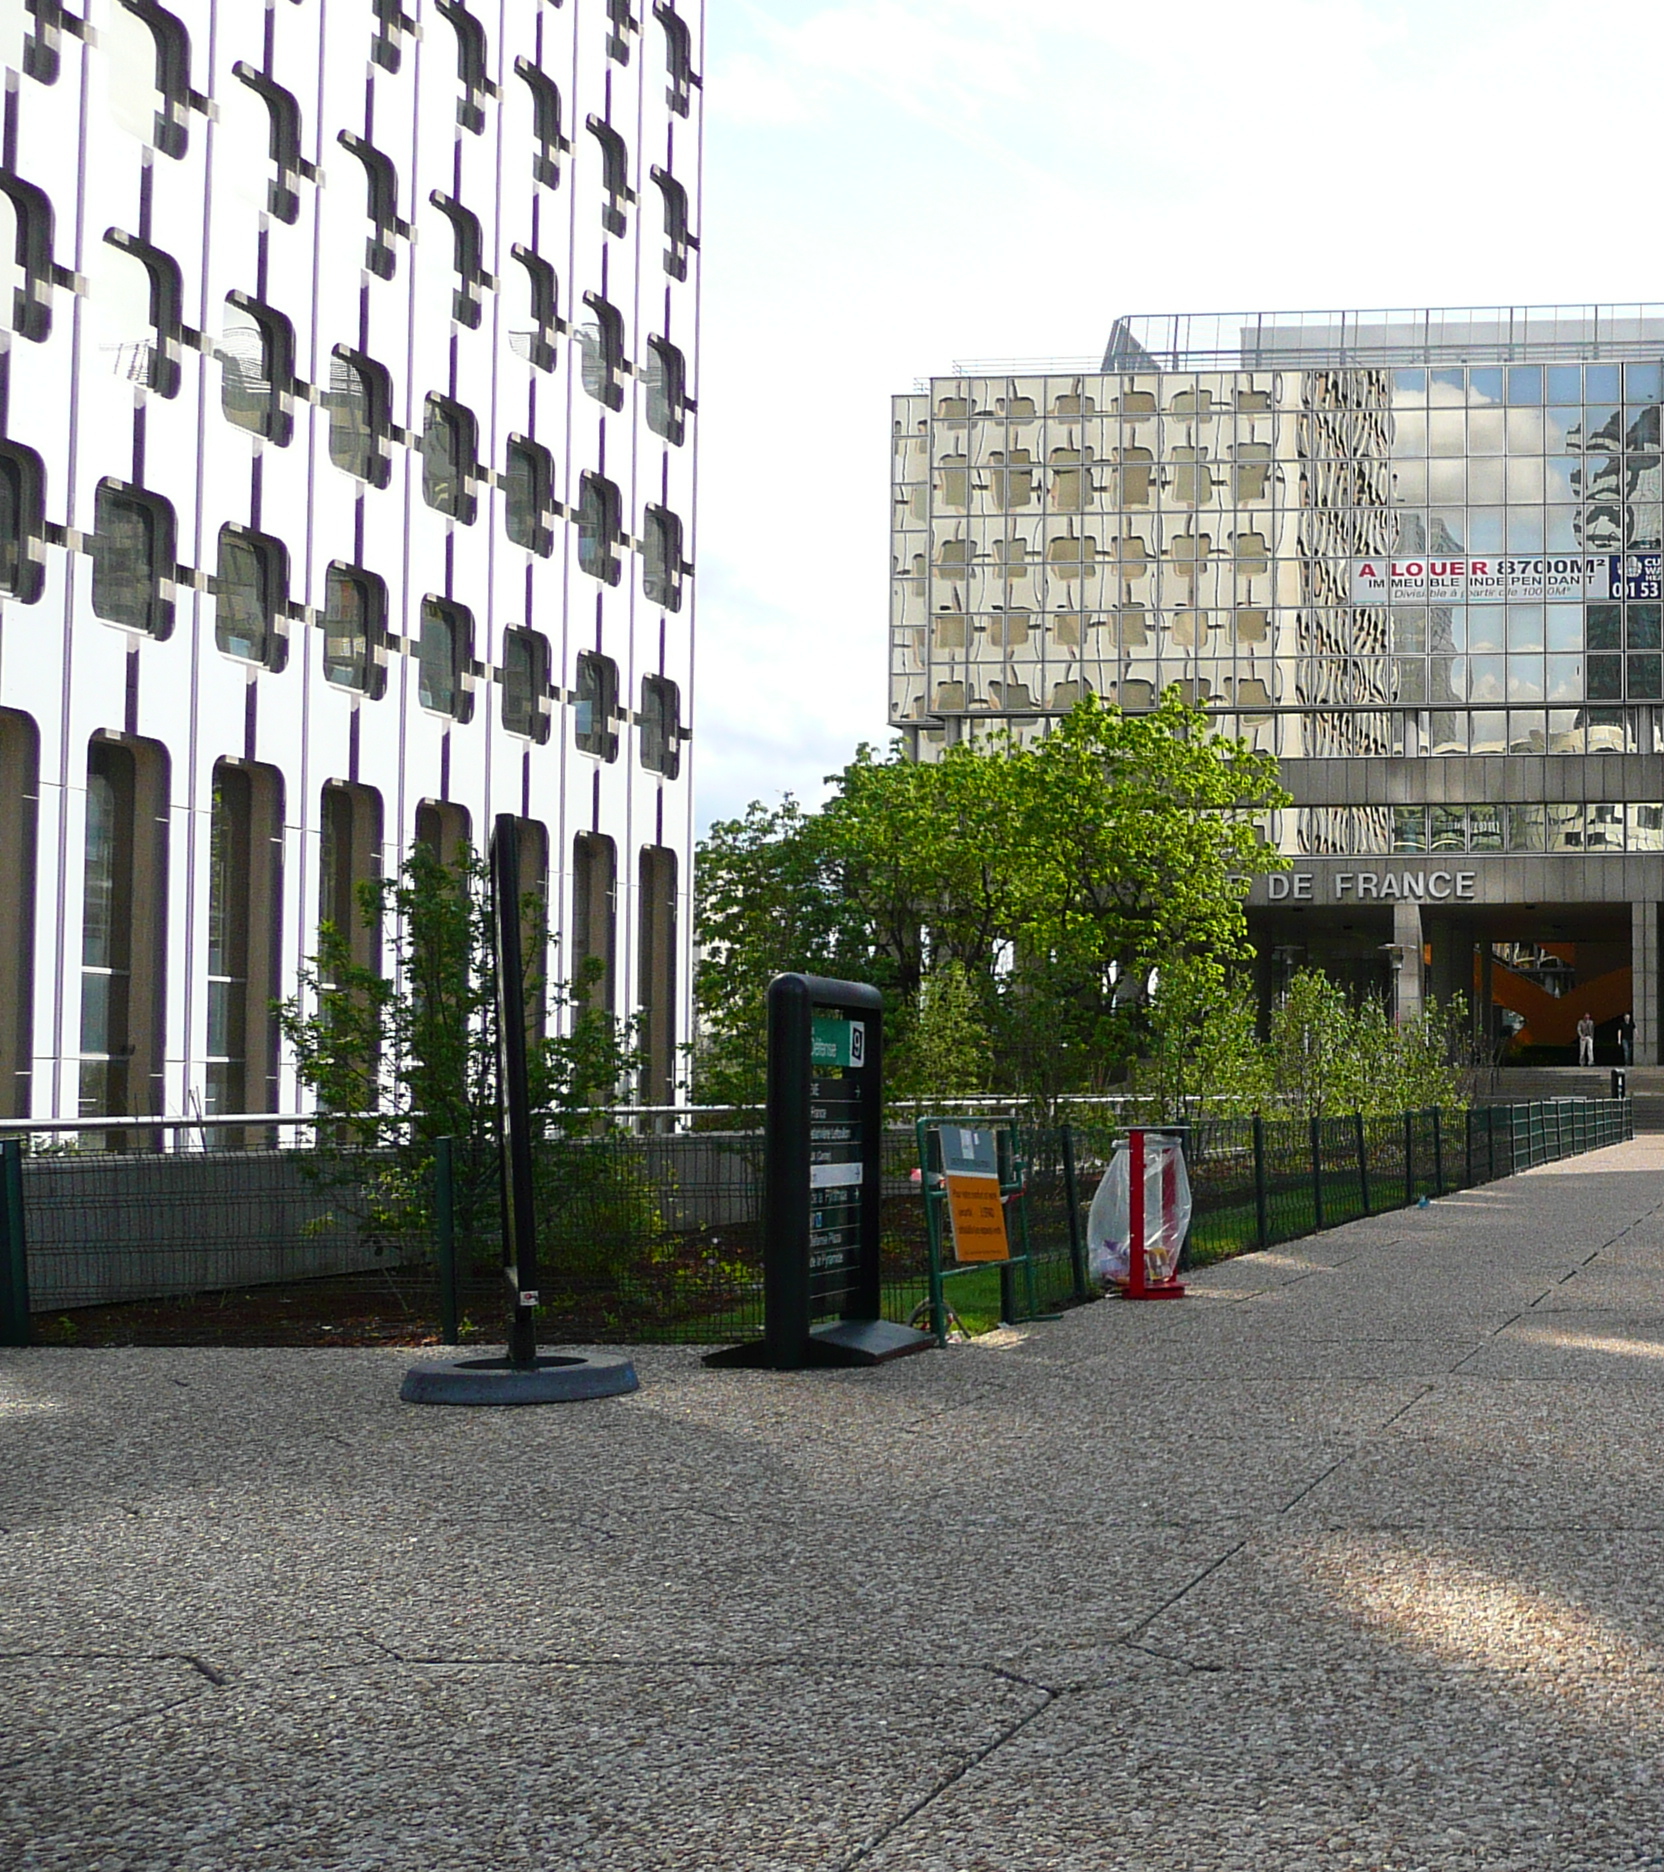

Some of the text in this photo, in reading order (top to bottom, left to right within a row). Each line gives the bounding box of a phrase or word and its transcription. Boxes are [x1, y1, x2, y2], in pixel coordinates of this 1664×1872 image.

[1358, 563, 1376, 577] A
[1391, 561, 1488, 577] LOUER
[1368, 575, 1595, 588] IMMEUBLE INDEPENDANT
[1612, 581, 1636, 598] 01
[1640, 581, 1659, 598] 53
[1394, 587, 1449, 599] Divisible
[1461, 587, 1495, 599] partir
[1498, 586, 1519, 597] de
[1268, 873, 1313, 900] DE
[1335, 871, 1476, 900] FRANCE
[853, 1031, 861, 1057] 9
